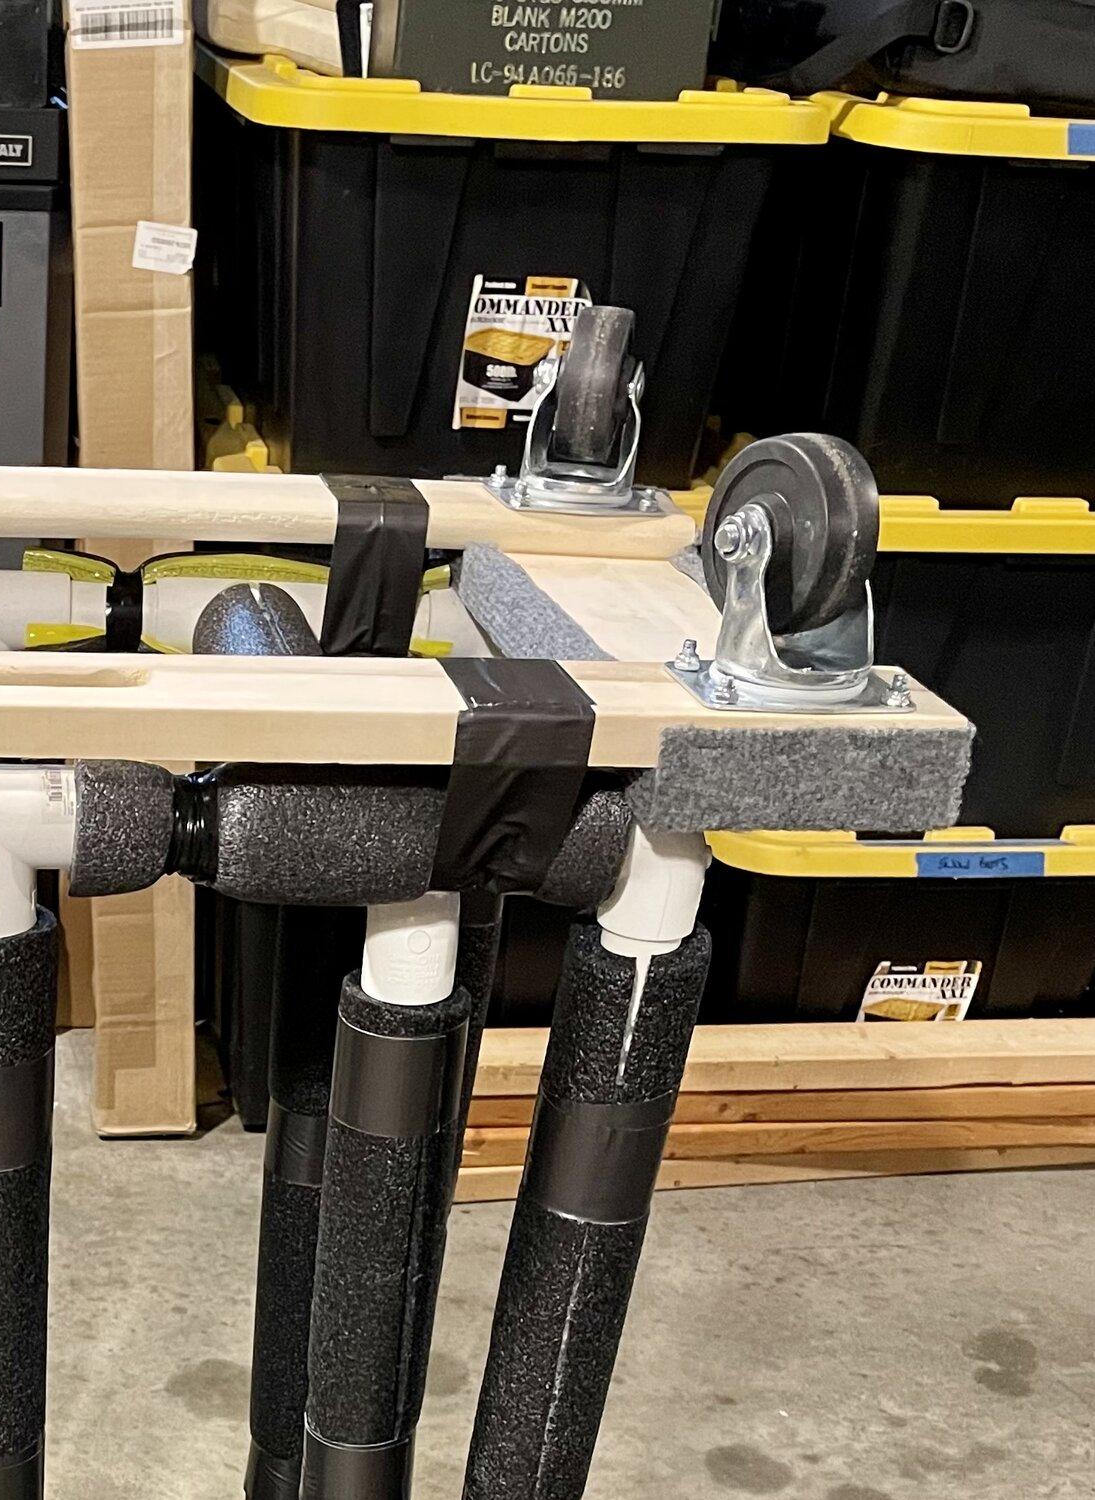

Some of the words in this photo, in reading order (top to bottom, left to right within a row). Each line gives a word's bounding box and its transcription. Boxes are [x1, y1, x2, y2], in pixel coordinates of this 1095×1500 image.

[491, 5, 551, 28] BLANK
[558, 7, 613, 30] M200
[504, 30, 590, 54] CARTONS
[473, 298, 586, 317] OMMANDE
[545, 317, 572, 333] XX
[870, 976, 972, 989] COMMANDER
